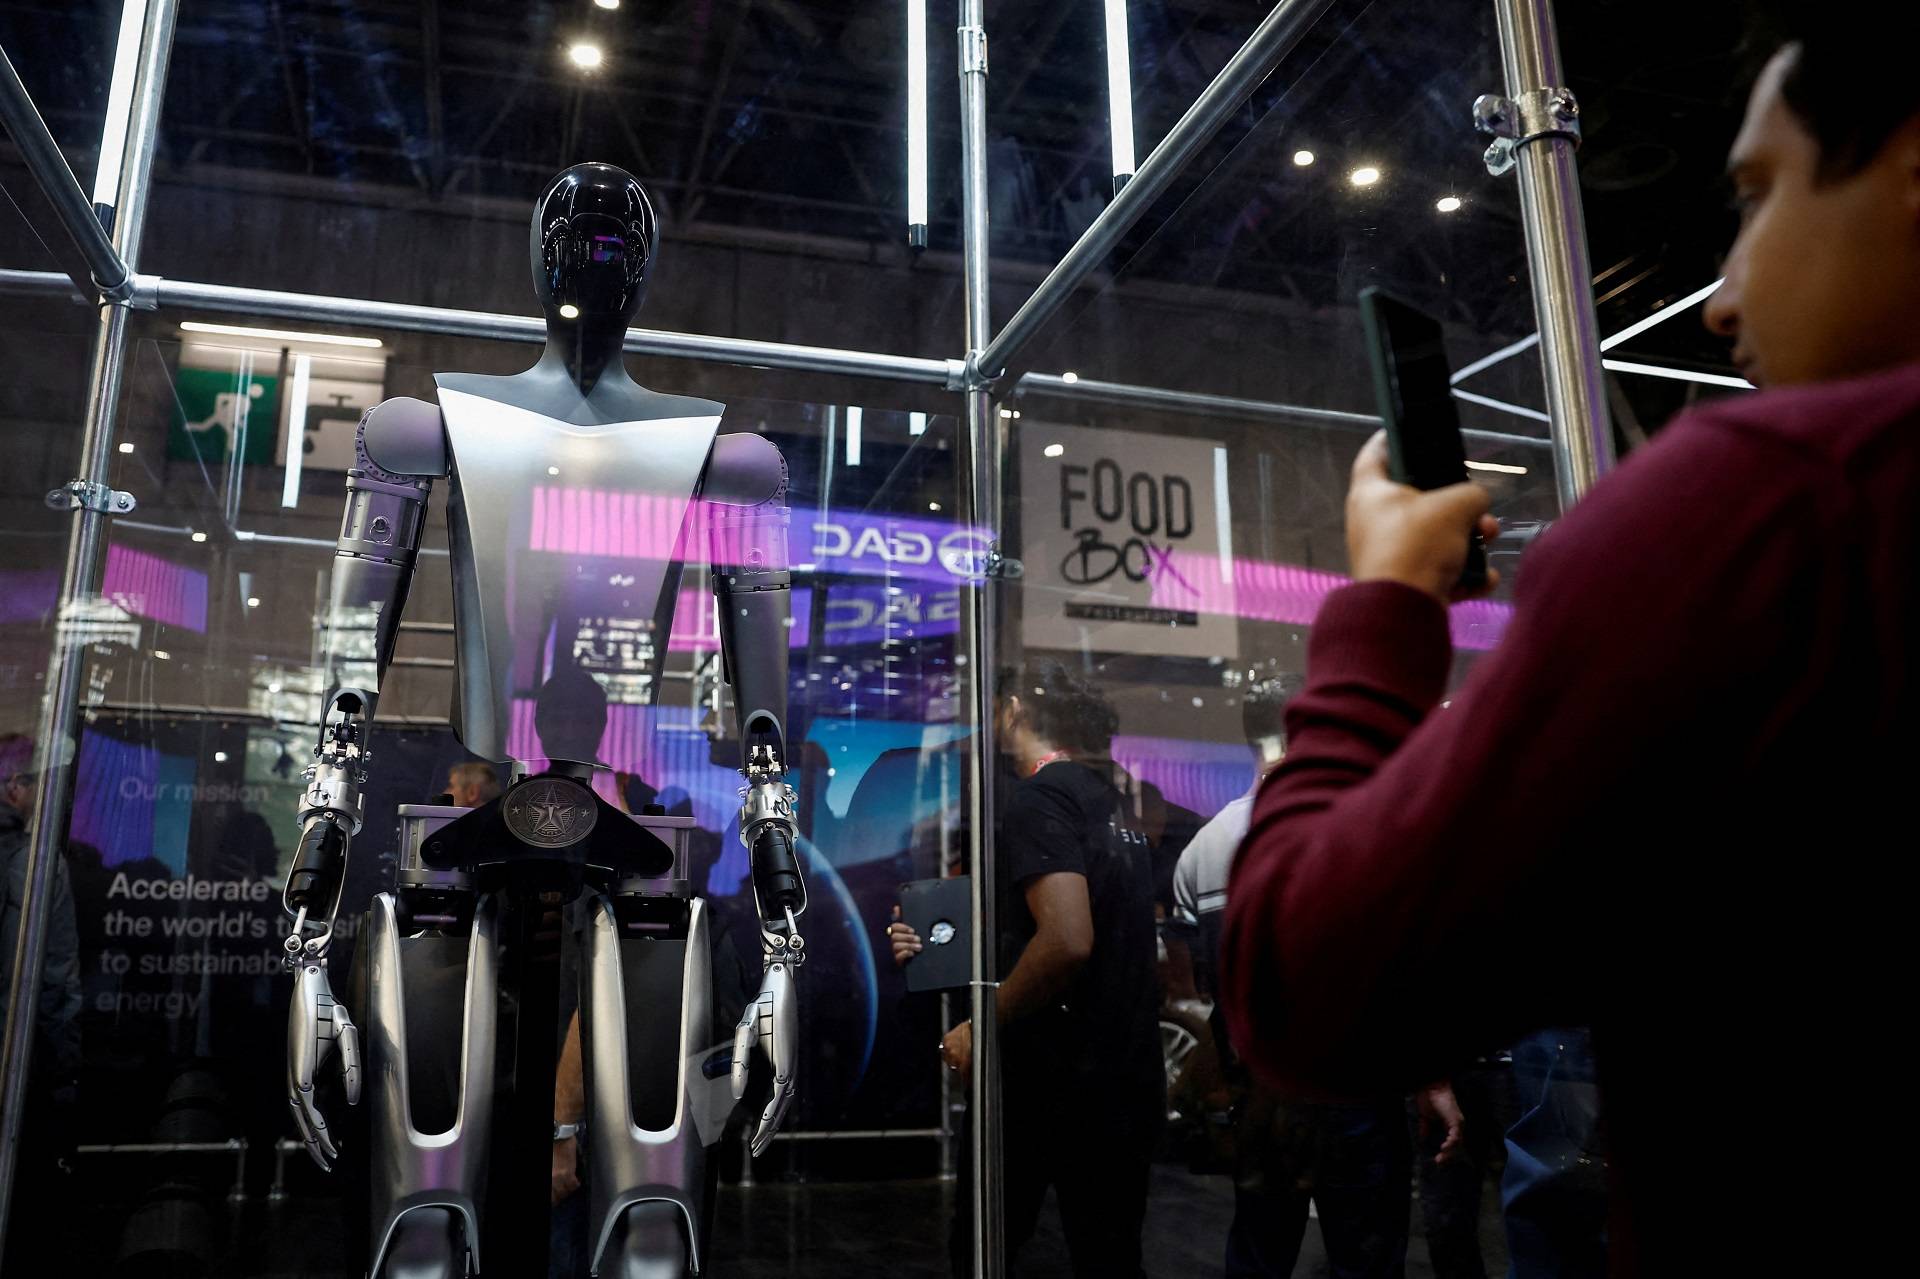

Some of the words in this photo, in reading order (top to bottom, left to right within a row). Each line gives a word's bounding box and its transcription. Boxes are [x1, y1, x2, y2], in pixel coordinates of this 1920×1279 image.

[1061, 458, 1192, 538] FOOD
[119, 777, 166, 799] Our
[174, 779, 269, 802] mission
[107, 872, 270, 902] Accelerate
[103, 910, 154, 938] the
[161, 910, 268, 939] world's
[100, 948, 131, 975] to
[139, 948, 281, 976] sustainab
[96, 990, 200, 1019] energy
